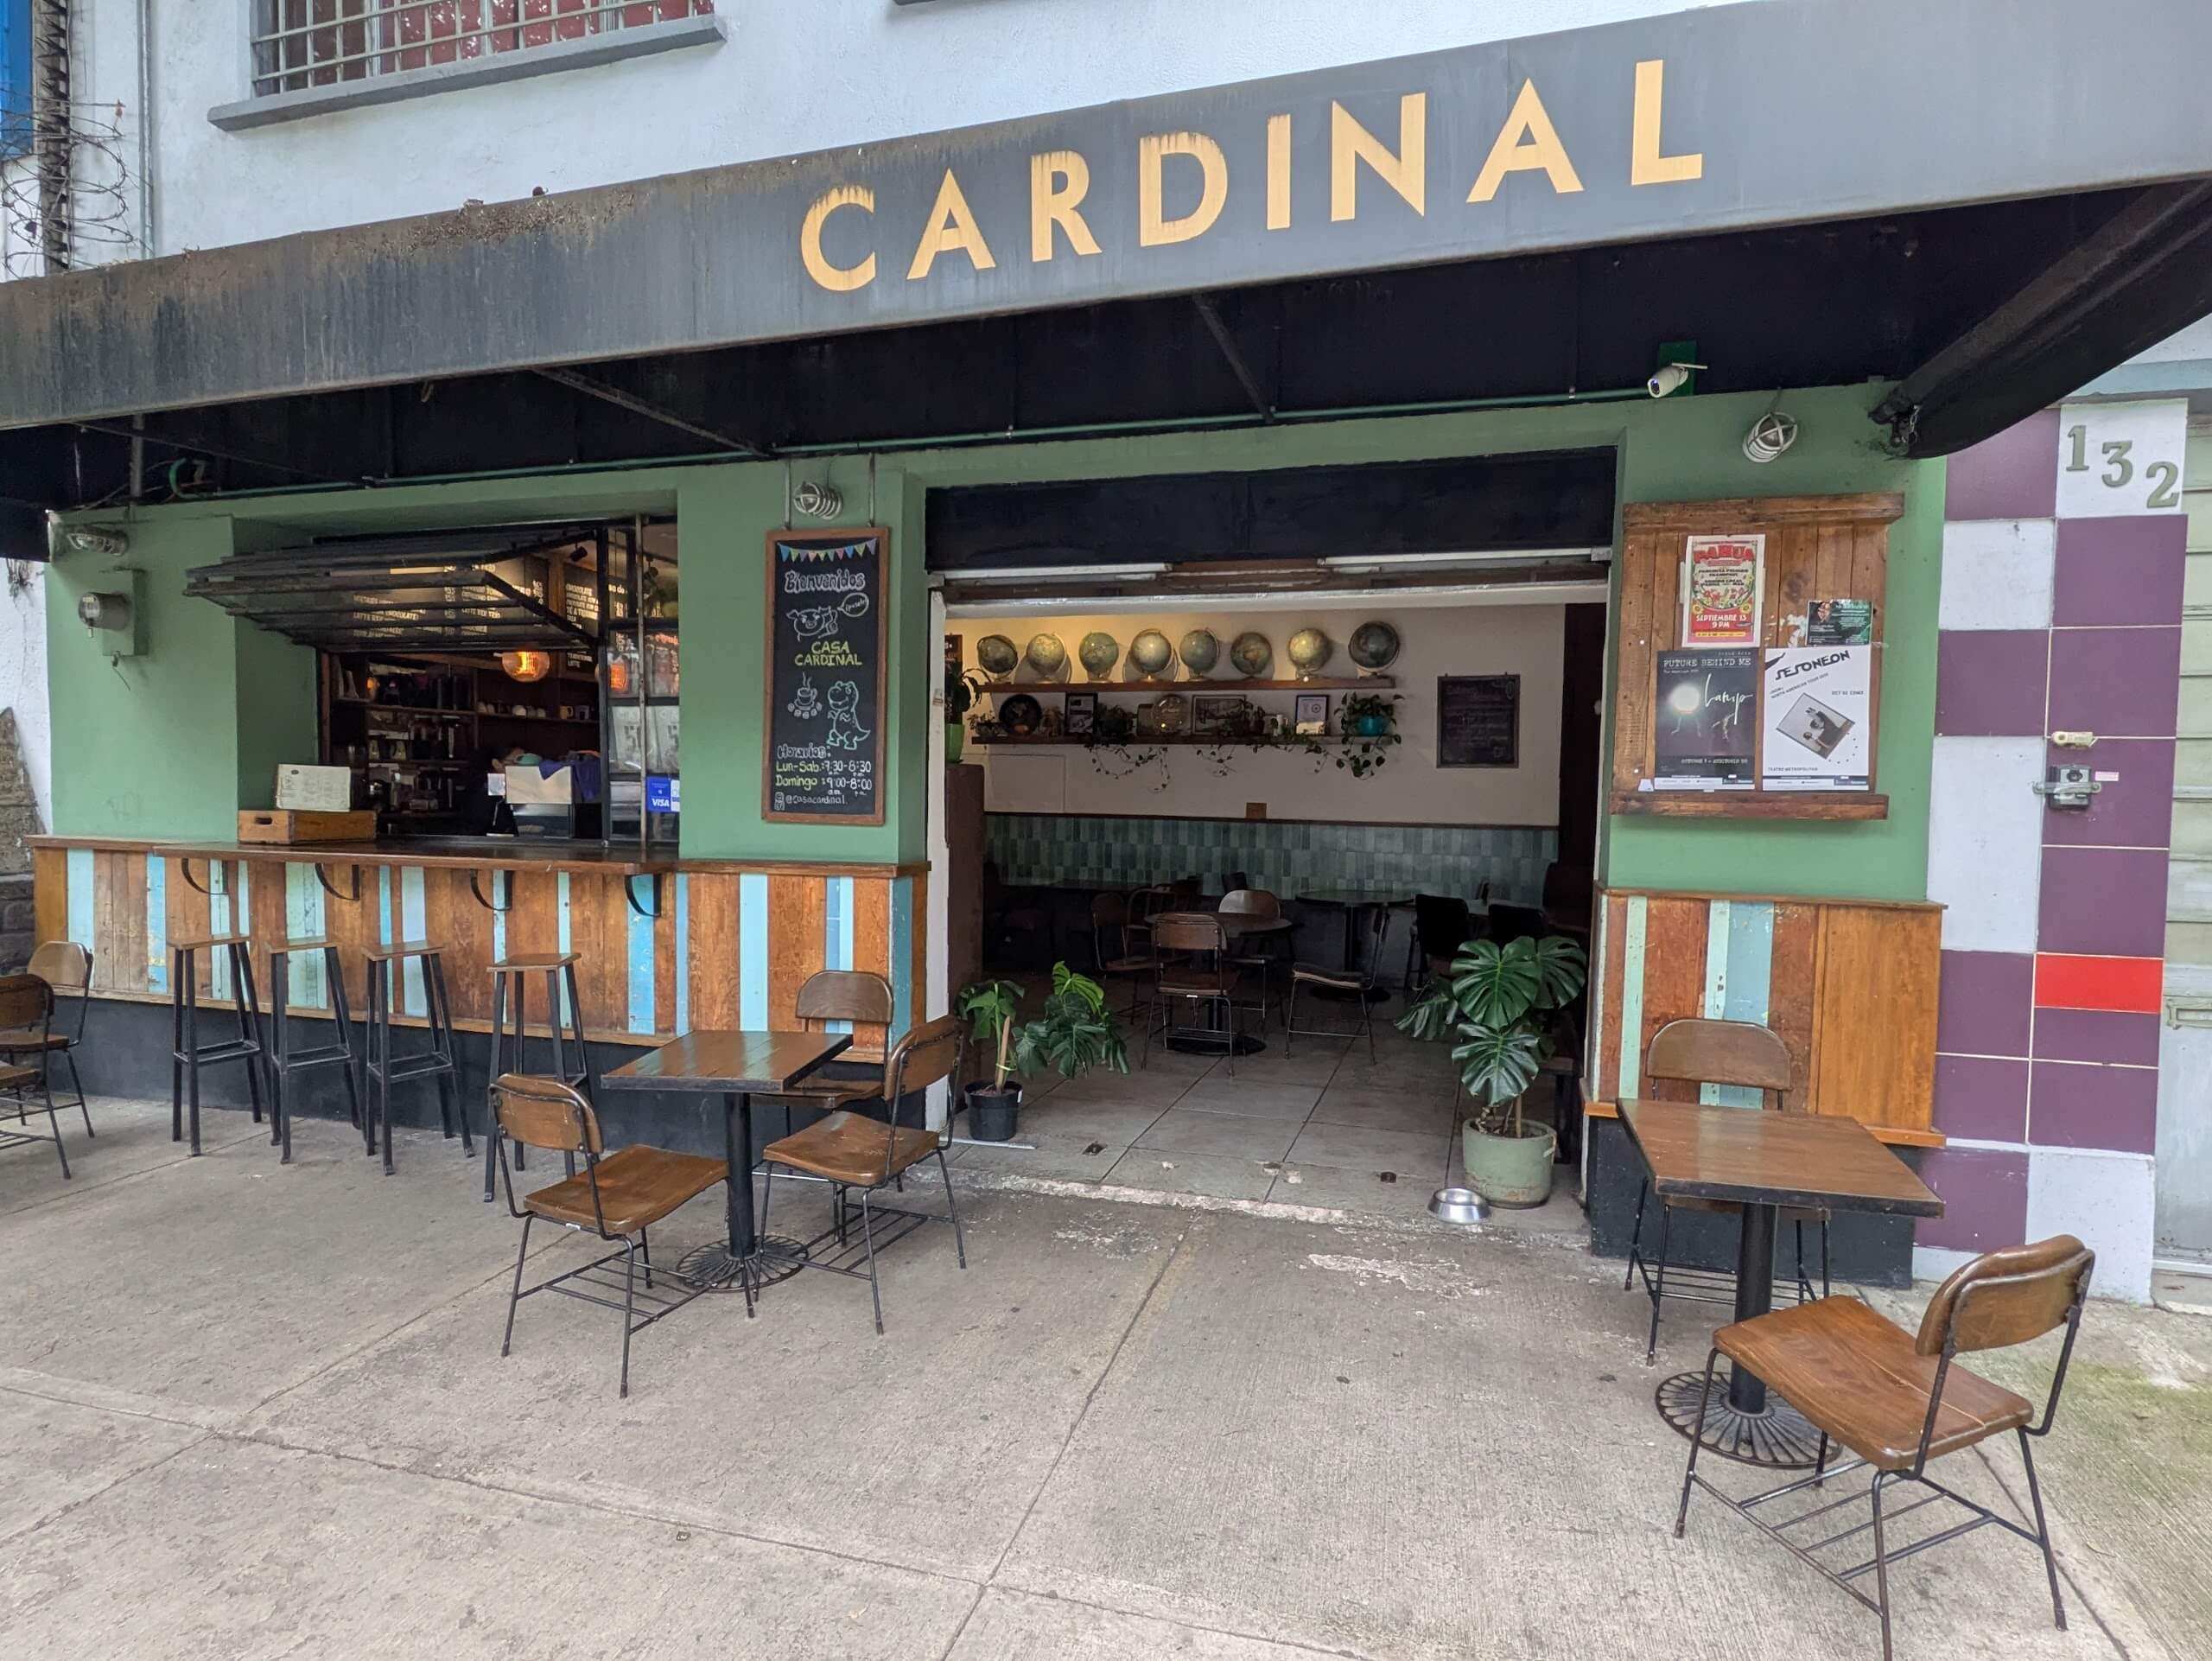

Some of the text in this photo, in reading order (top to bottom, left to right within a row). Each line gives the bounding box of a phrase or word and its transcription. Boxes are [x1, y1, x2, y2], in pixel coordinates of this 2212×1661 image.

[800, 59, 1703, 292] CARDINAL
[2066, 425, 2180, 508] 132
[784, 569, 866, 594] Bienvenidos
[811, 640, 850, 654] CASA
[795, 653, 863, 666] CARDINAL
[1663, 659, 1698, 667] FUTURE
[1700, 658, 1736, 666] BEHIND
[775, 774, 817, 791] Domingo
[652, 798, 670, 807] VISA
